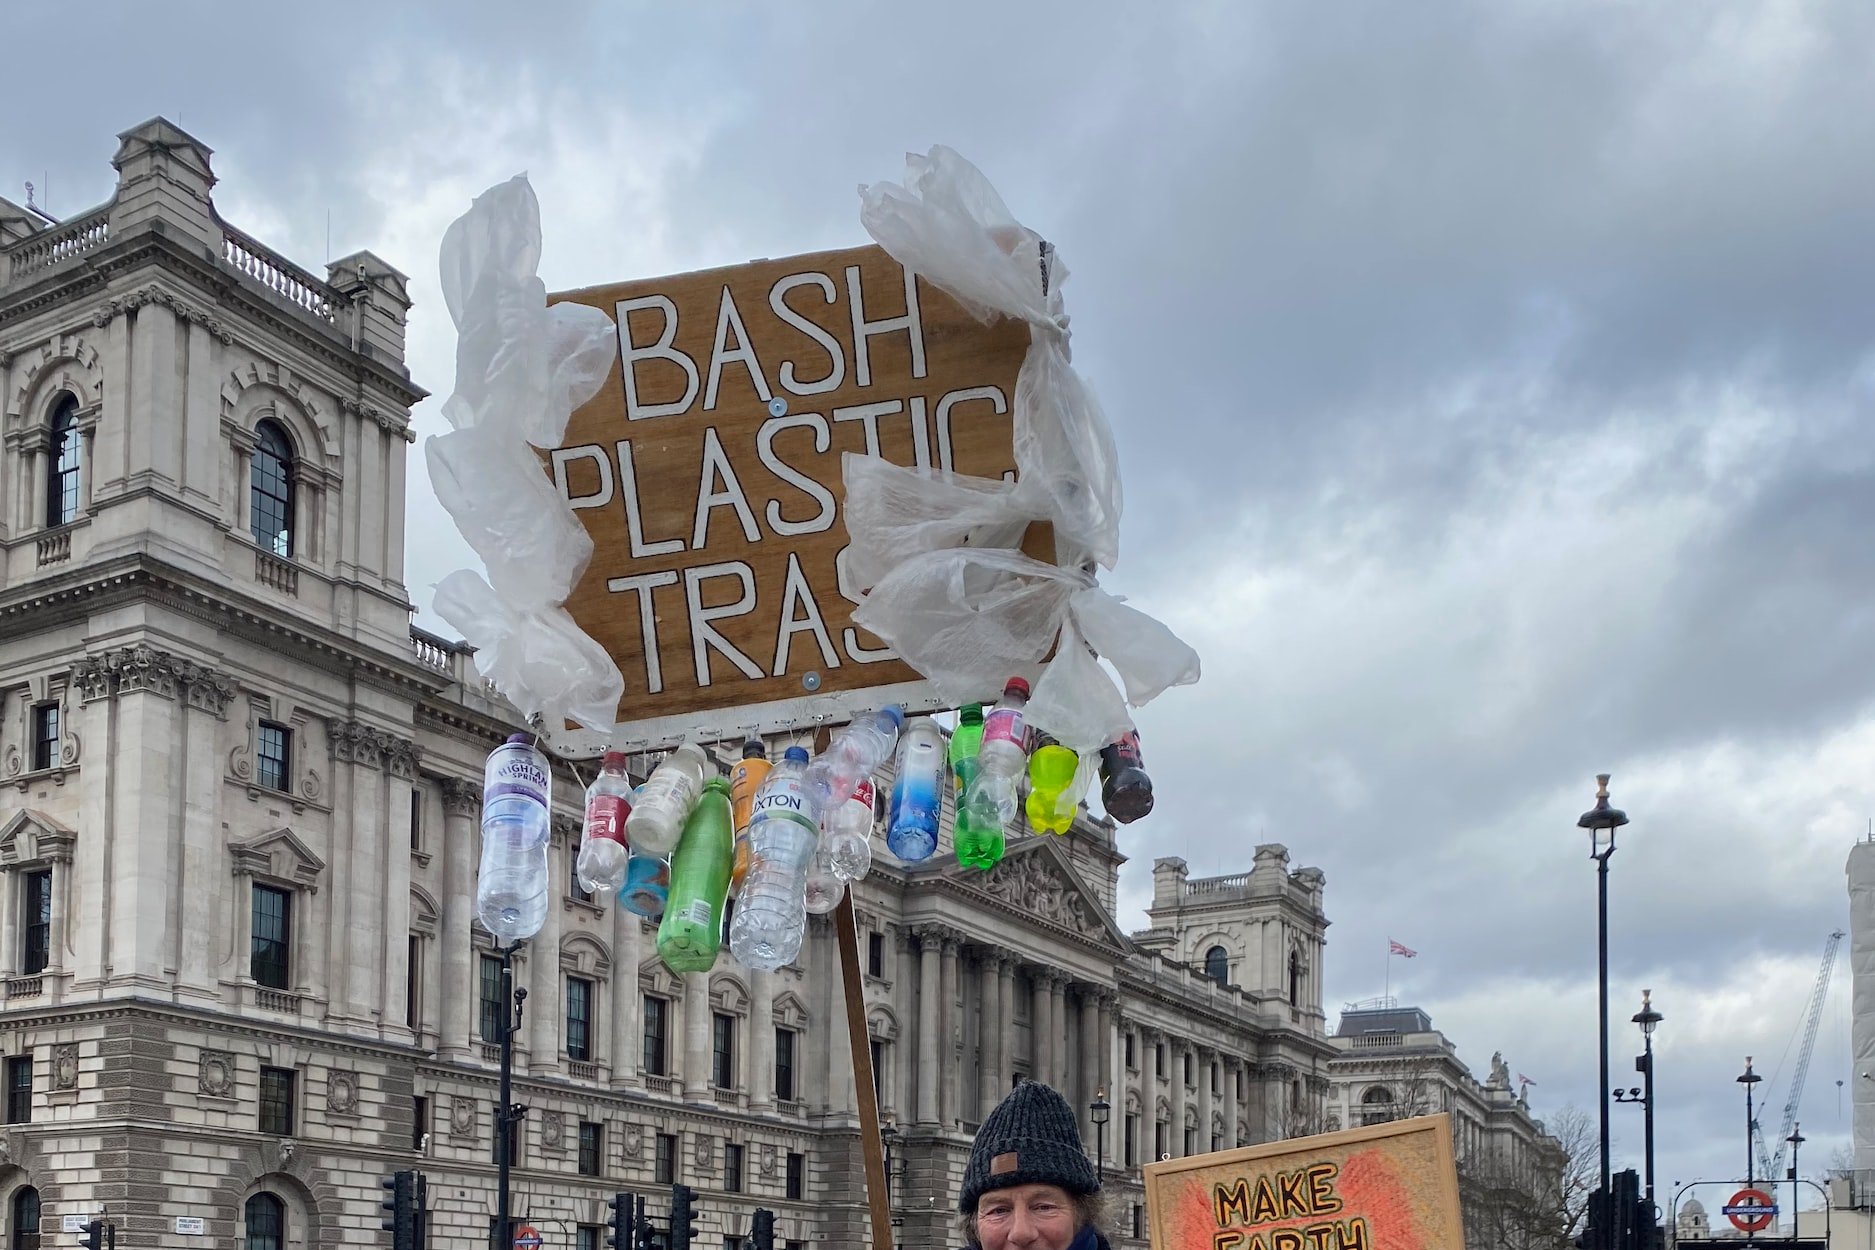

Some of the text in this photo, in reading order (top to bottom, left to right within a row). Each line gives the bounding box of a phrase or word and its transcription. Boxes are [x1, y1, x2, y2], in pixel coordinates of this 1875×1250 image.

[616, 264, 927, 422] BASH
[608, 551, 900, 694] TRA
[753, 794, 801, 812] XTON
[1213, 1162, 1342, 1228] MAKE
